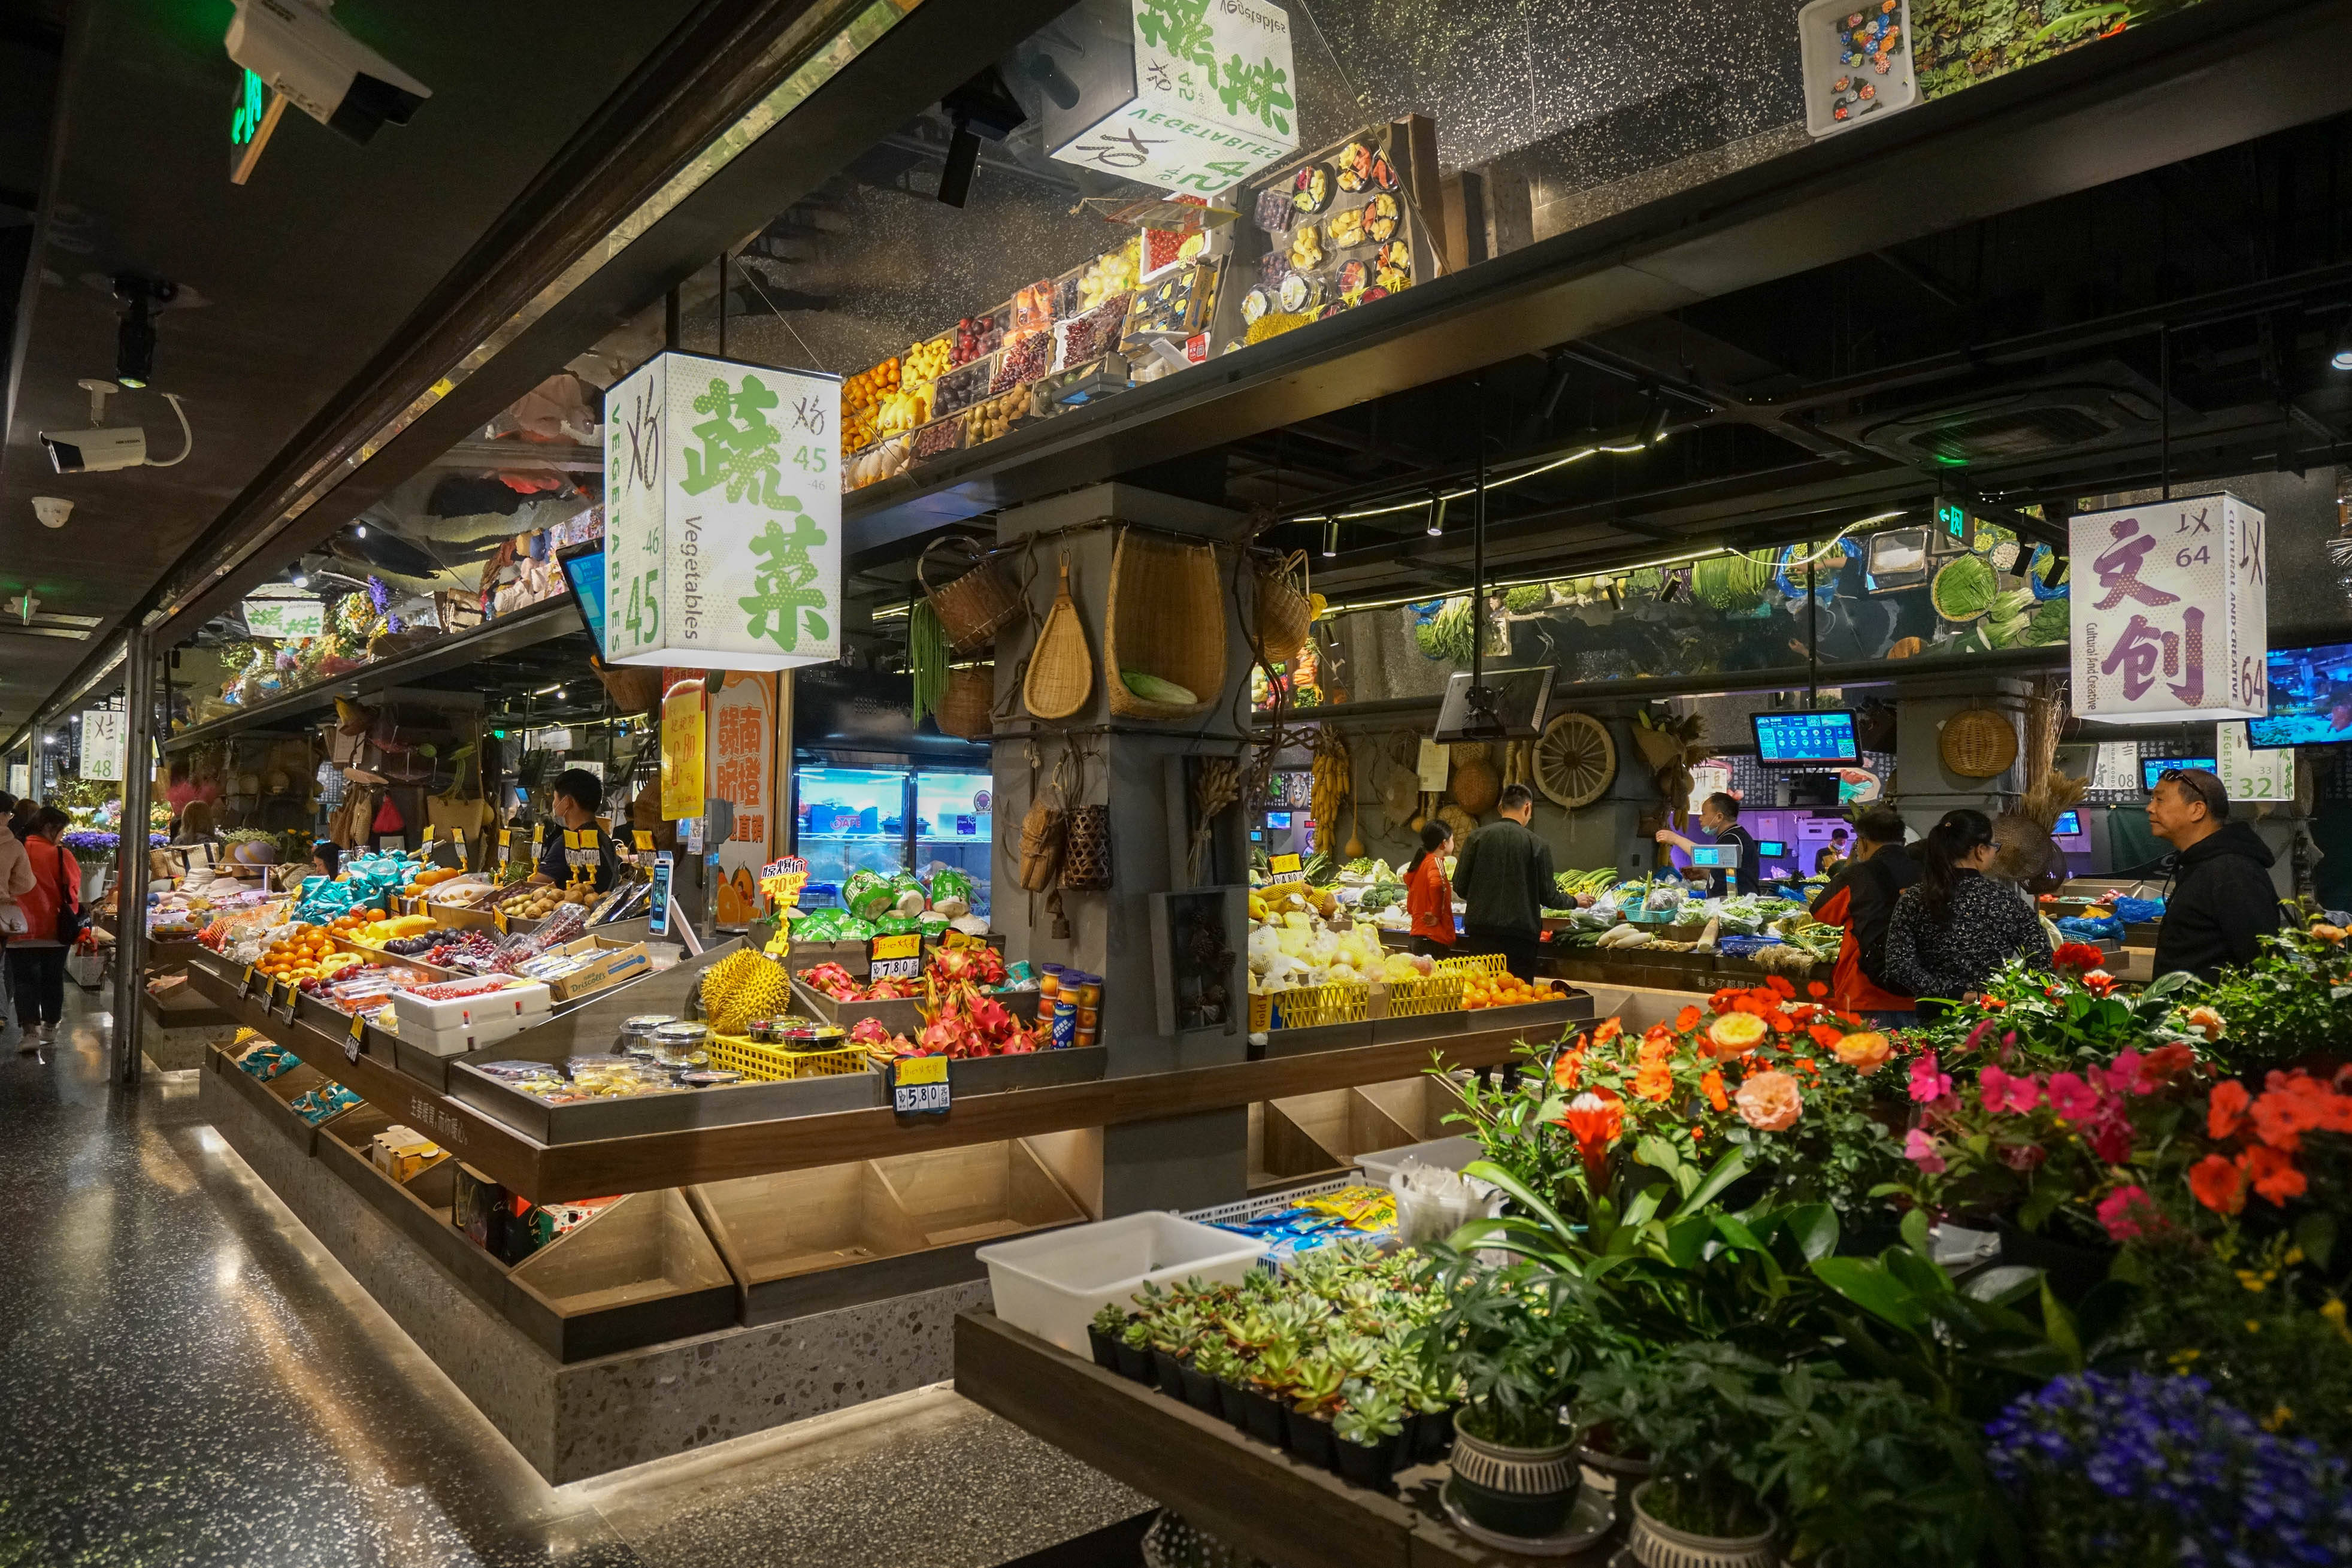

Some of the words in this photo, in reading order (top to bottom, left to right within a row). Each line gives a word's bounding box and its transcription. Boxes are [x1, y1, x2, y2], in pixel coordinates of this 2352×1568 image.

[792, 445, 827, 473] 45
[679, 374, 830, 652] 蔬菜
[612, 402, 620, 653] VEGETABLES
[2176, 546, 2211, 567] 64
[680, 516, 703, 640] Vegetables
[625, 568, 658, 646] 45
[2092, 518, 2205, 707] 文创
[2086, 622, 2097, 656] Cultural
[2087, 658, 2099, 674] And
[2087, 675, 2099, 710] Creative
[2242, 656, 2265, 709] 64
[83, 716, 92, 777] VEGETABLES
[92, 759, 111, 777] 48
[2118, 774, 2134, 788] 08
[2239, 777, 2272, 798] 32
[830, 815, 861, 830] SAFE
[762, 858, 804, 877] 惊爆价
[882, 961, 908, 976] 7.80
[1255, 1004, 1266, 1027] Gold
[908, 1087, 937, 1107] 5.80
